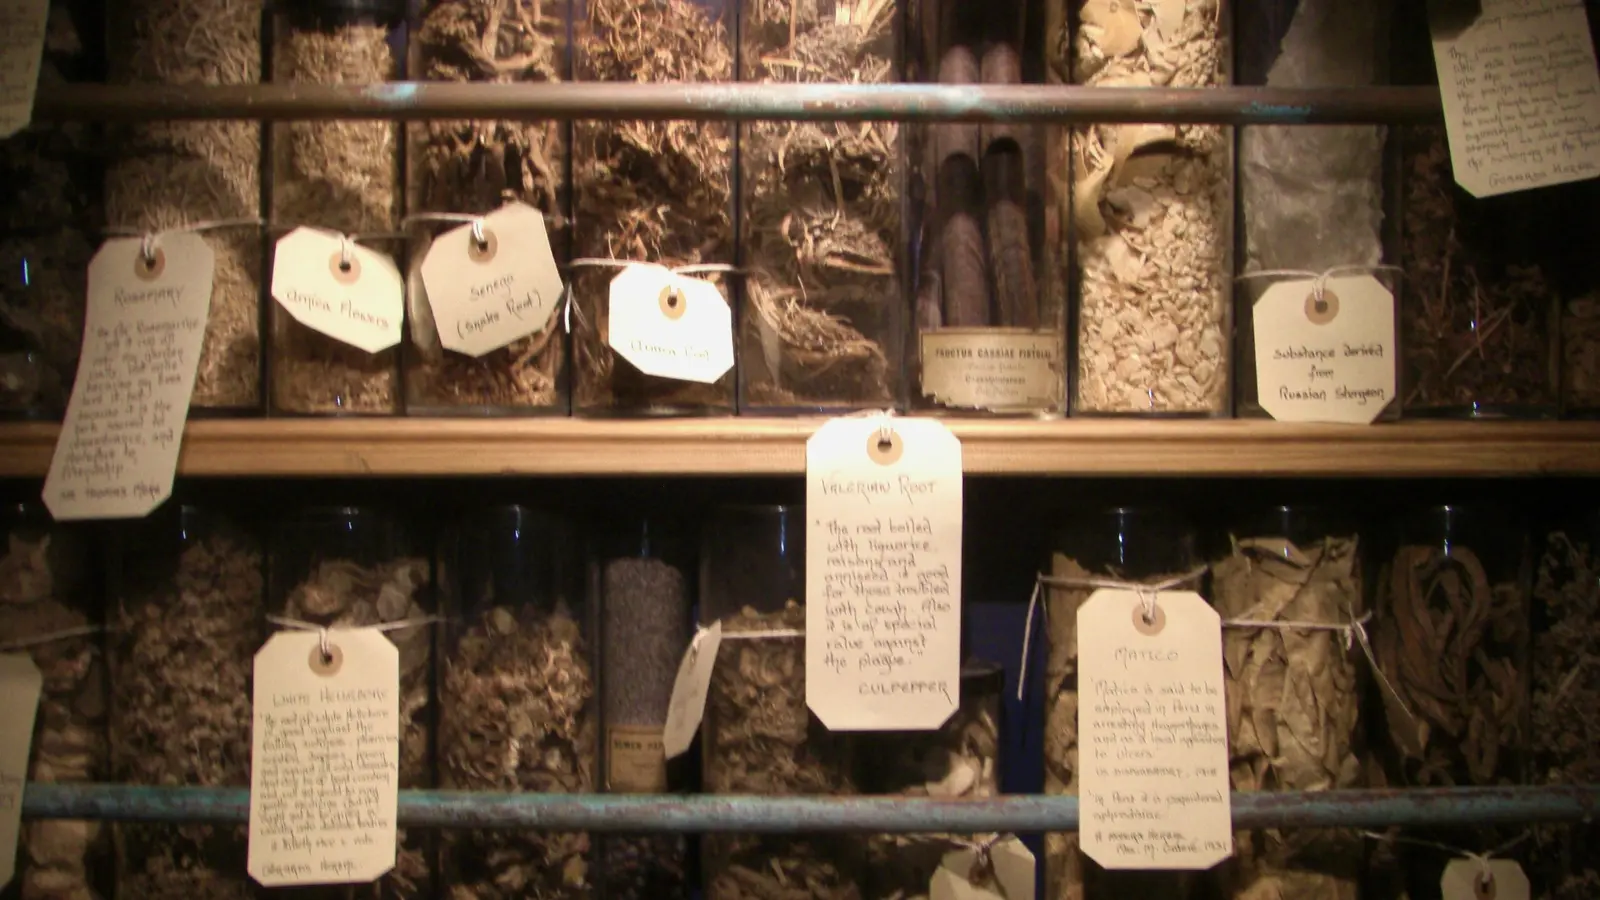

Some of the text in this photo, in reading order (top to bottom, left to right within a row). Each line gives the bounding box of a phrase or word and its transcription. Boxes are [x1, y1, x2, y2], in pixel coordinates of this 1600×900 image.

[1273, 344, 1336, 362] Substance
[1307, 363, 1335, 383] from
[1279, 384, 1385, 406] Russian Sturgeon
